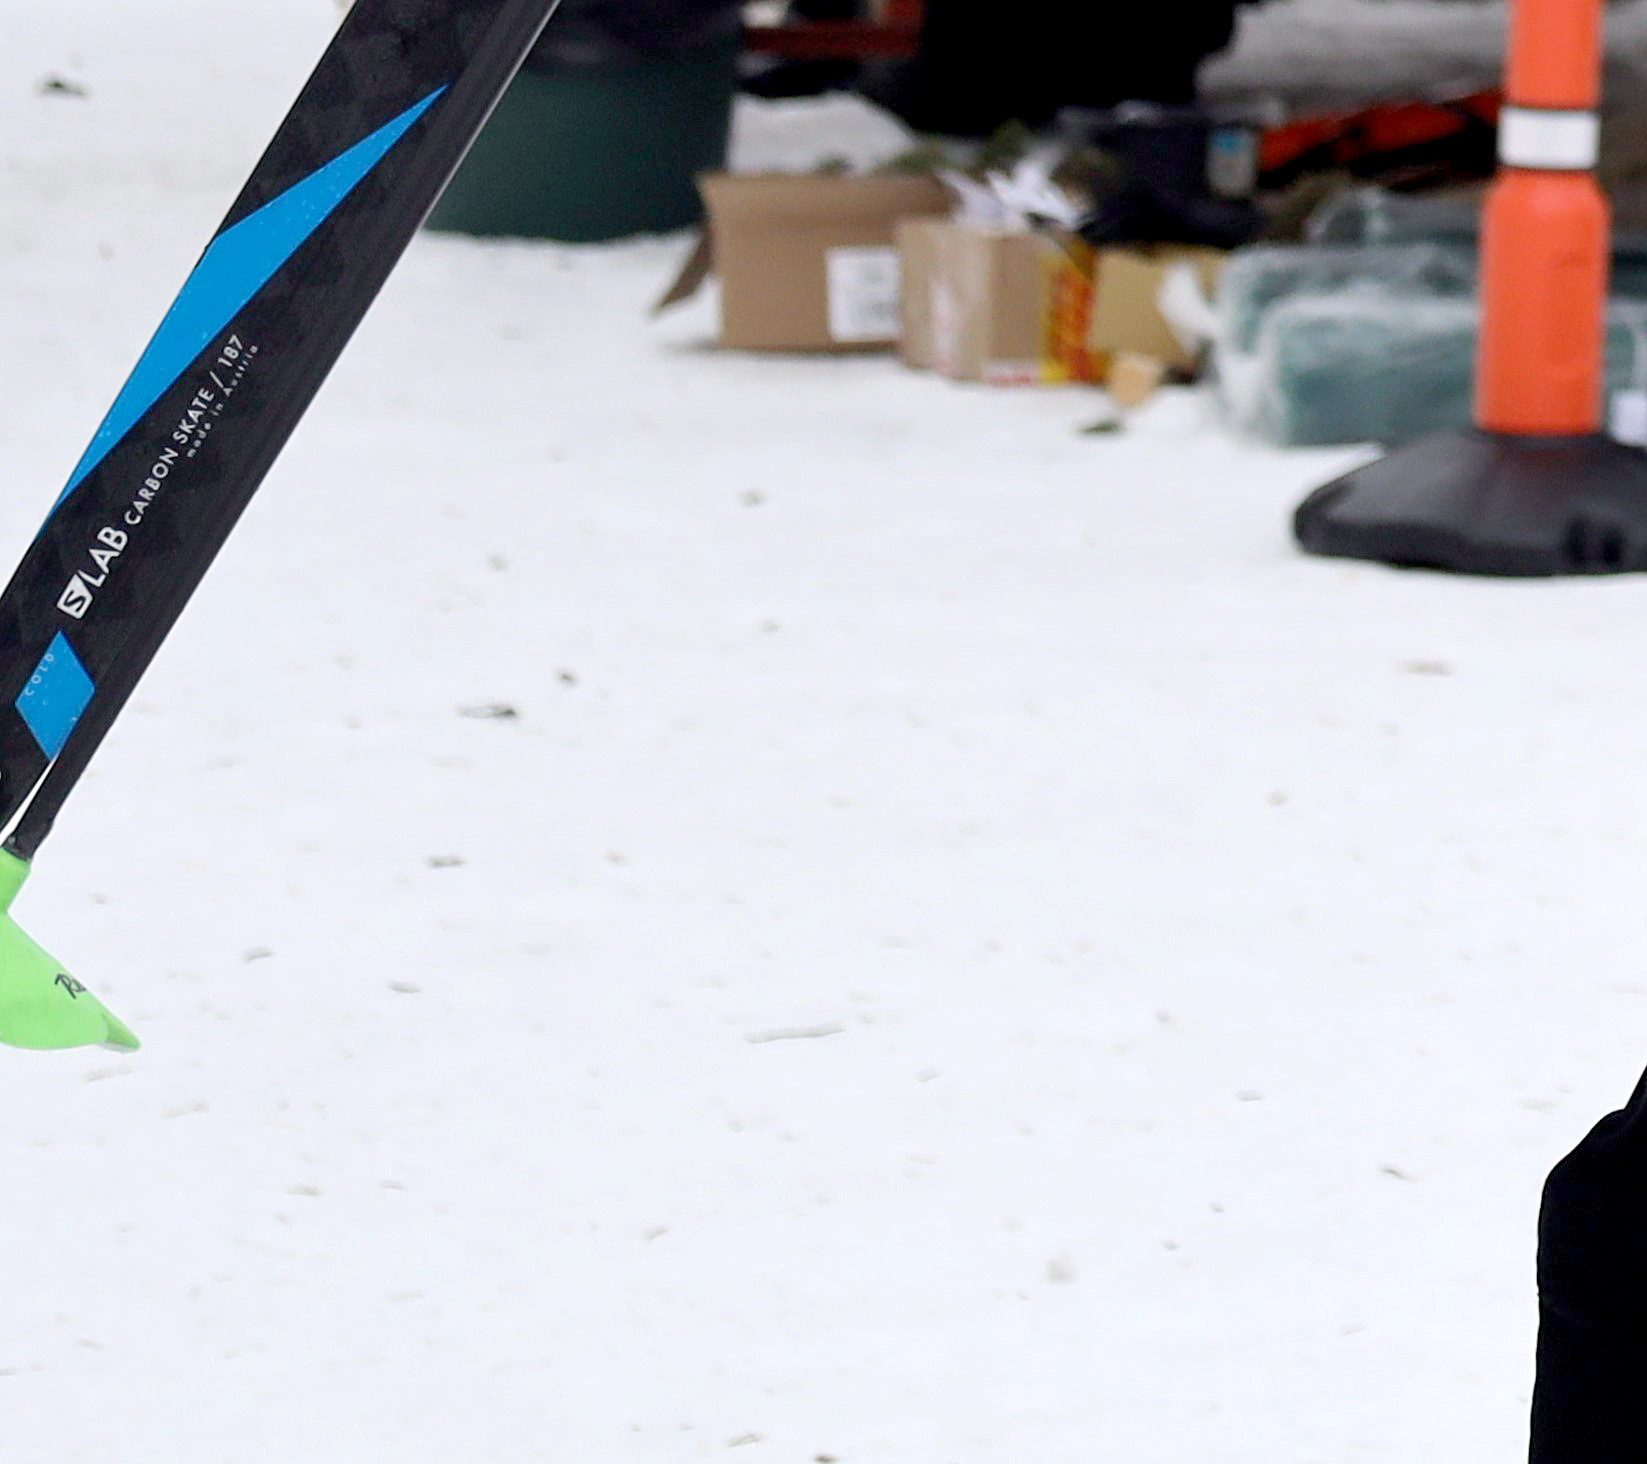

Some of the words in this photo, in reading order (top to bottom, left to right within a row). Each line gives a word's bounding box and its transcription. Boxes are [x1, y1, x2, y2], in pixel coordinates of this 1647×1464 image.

[124, 448, 179, 525] CARBON
[172, 387, 215, 445] SKATE
[217, 334, 244, 368] 187
